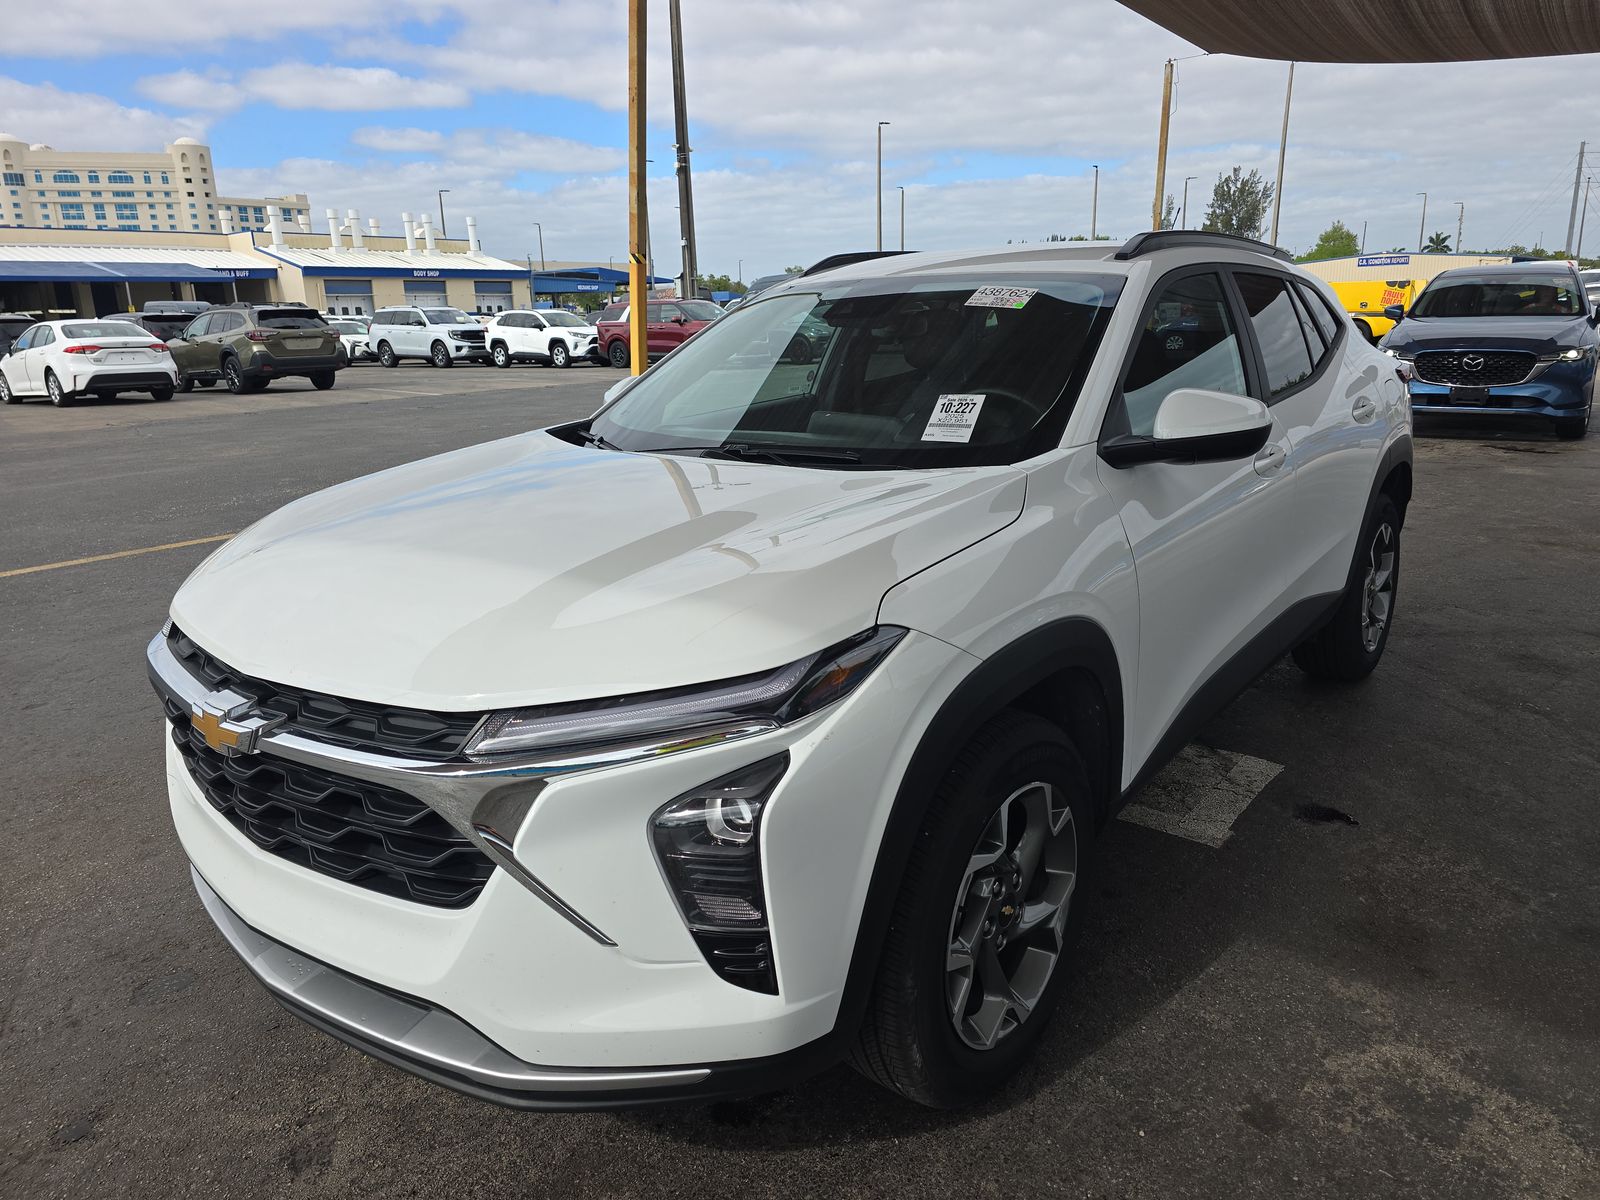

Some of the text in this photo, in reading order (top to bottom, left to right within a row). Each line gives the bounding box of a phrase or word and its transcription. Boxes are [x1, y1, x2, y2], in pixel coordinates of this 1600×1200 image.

[978, 287, 1035, 298] 4387624
[1383, 290, 1405, 299] TRULY
[940, 402, 977, 413] 10:227
